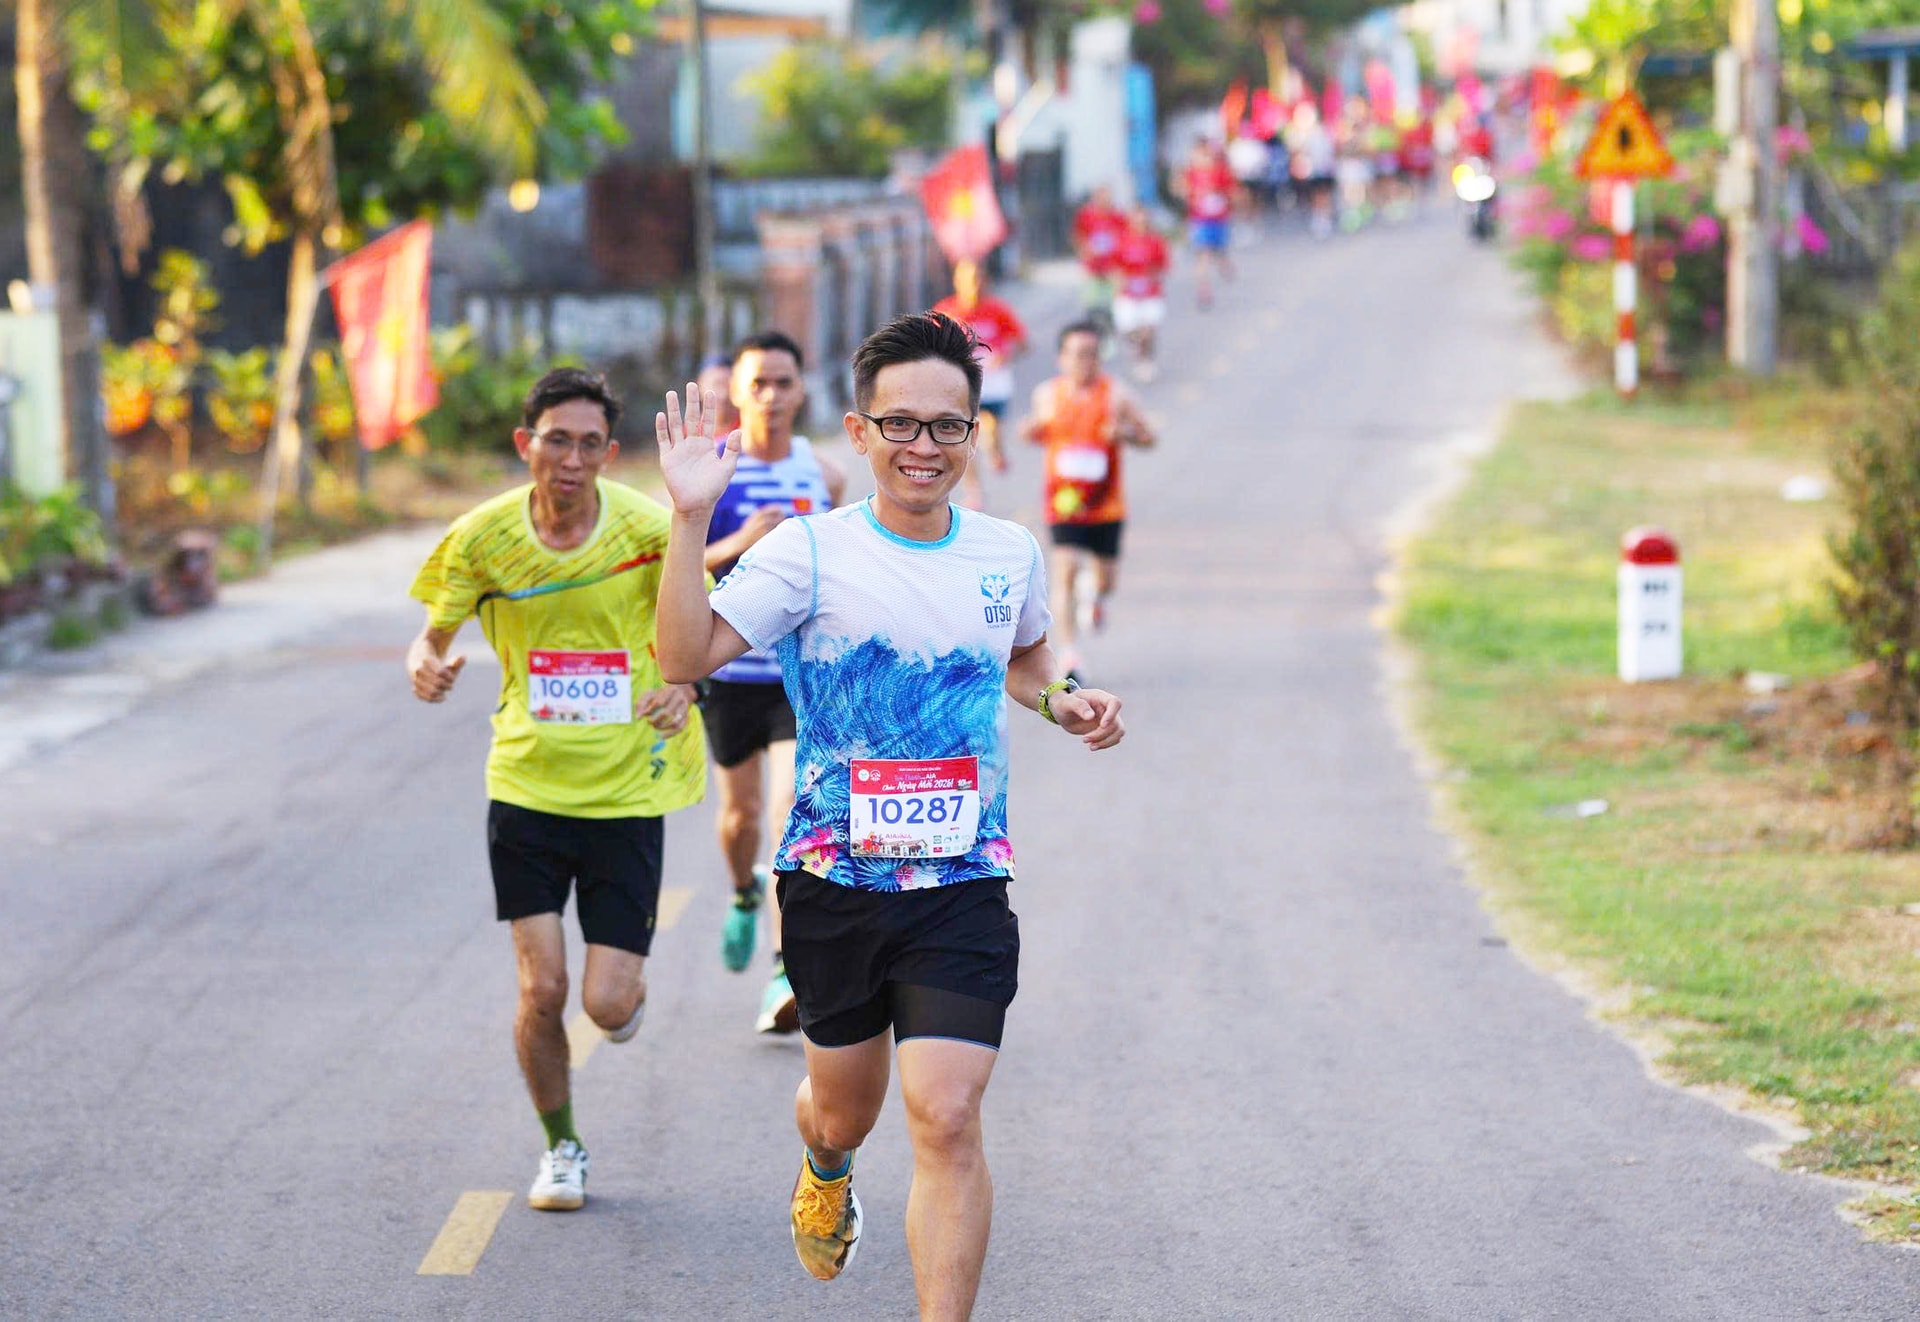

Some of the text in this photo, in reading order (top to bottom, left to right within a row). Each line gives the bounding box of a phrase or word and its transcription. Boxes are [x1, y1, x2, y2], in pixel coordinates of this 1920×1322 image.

[984, 605, 1011, 624] OTSO
[541, 677, 617, 699] 10608
[868, 795, 964, 824] 10287
